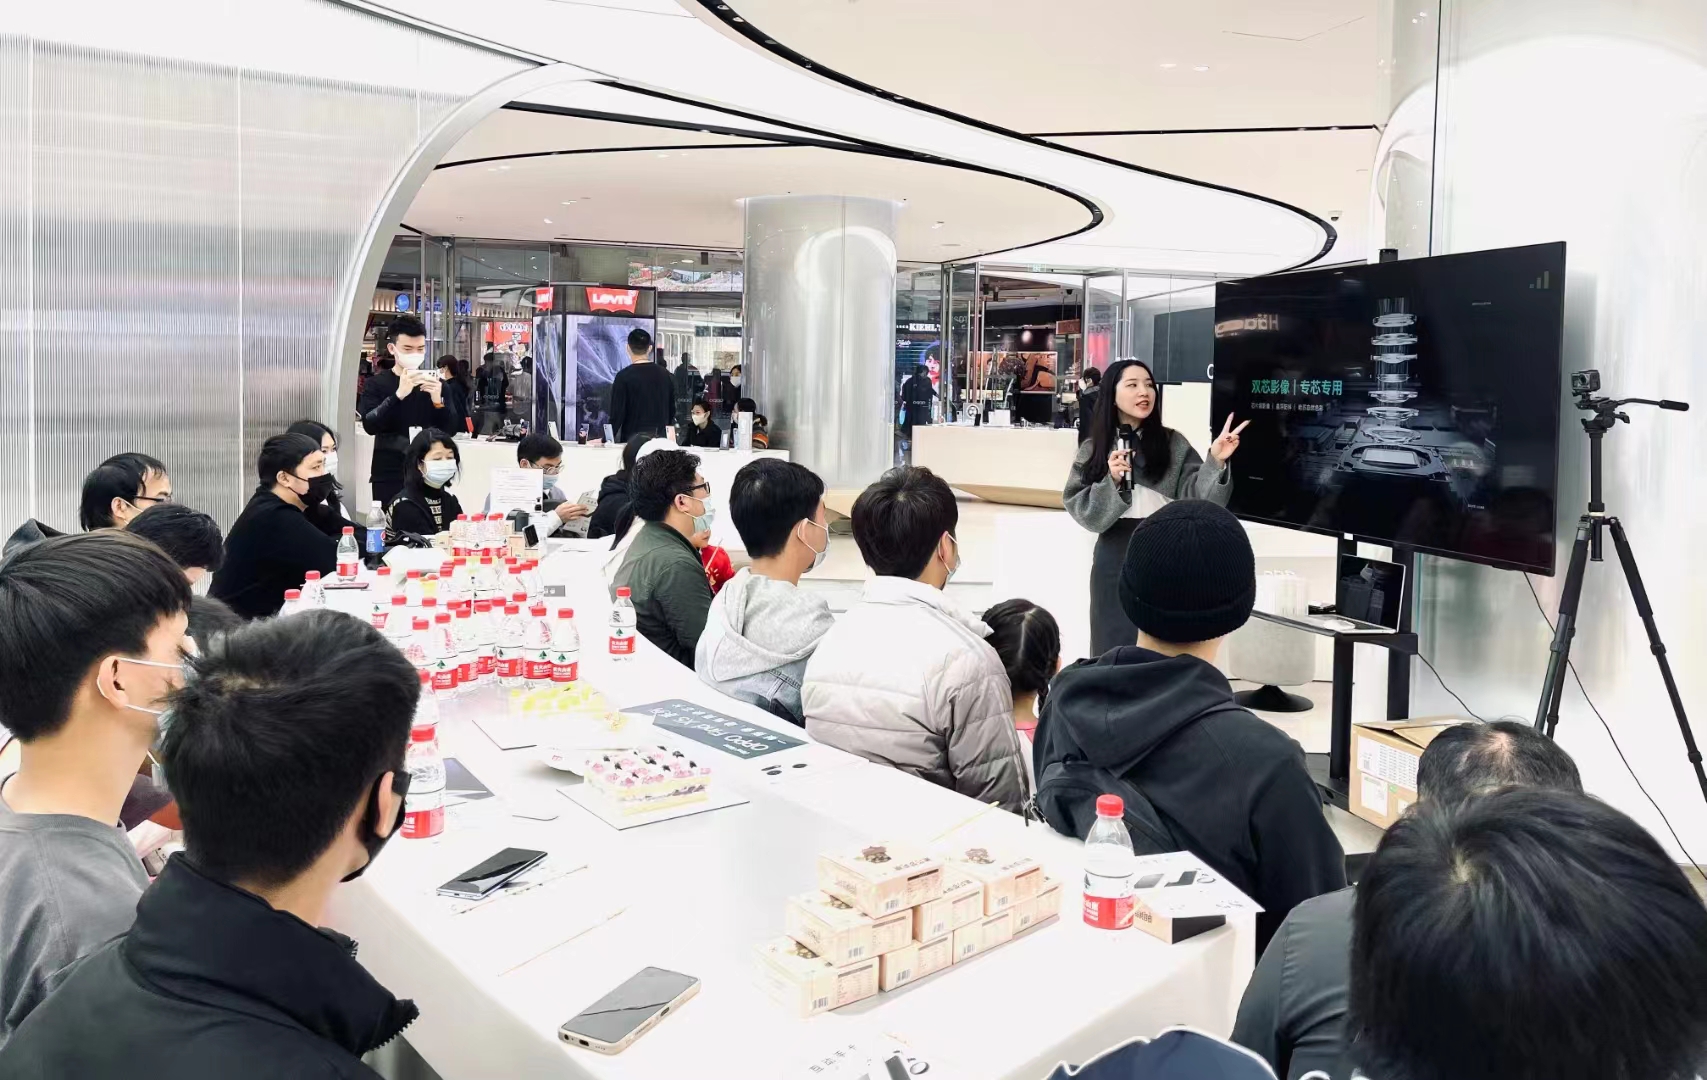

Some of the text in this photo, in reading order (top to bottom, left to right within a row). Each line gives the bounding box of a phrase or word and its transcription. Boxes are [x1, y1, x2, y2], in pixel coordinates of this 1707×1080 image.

[1251, 379, 1343, 396] 双芯影像 专芯专用
[723, 735, 769, 751] OPPO
